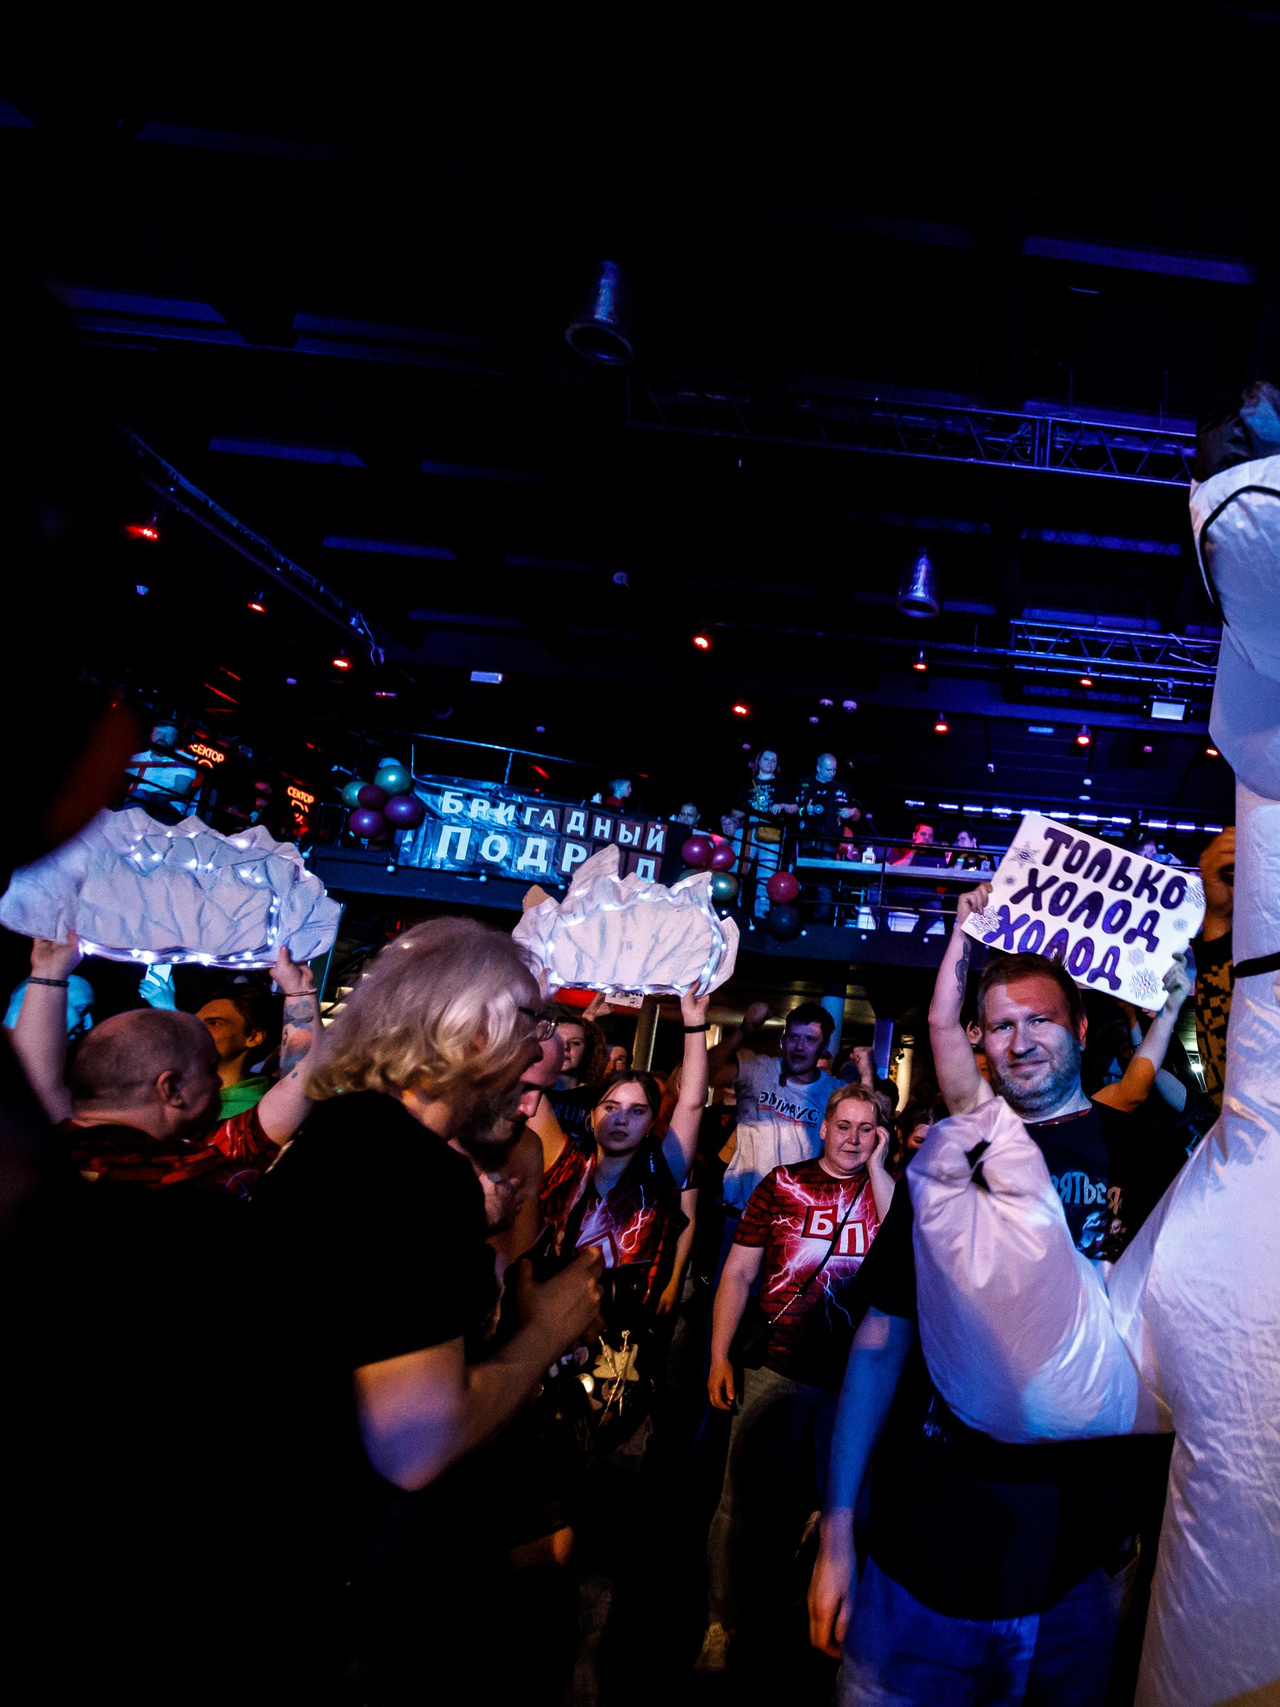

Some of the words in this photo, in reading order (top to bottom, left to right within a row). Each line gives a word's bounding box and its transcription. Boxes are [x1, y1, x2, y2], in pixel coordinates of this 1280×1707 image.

[189, 743, 225, 763] СЕКТОР
[287, 785, 315, 804] СЕКТОР
[442, 790, 665, 852] БРИГАДНЫЙ
[436, 825, 656, 883] ПОДРД
[1042, 826, 1188, 910] ТОЛЬКО
[1010, 868, 1160, 953] ХОЛОД
[982, 904, 1122, 991] ХОЛОД
